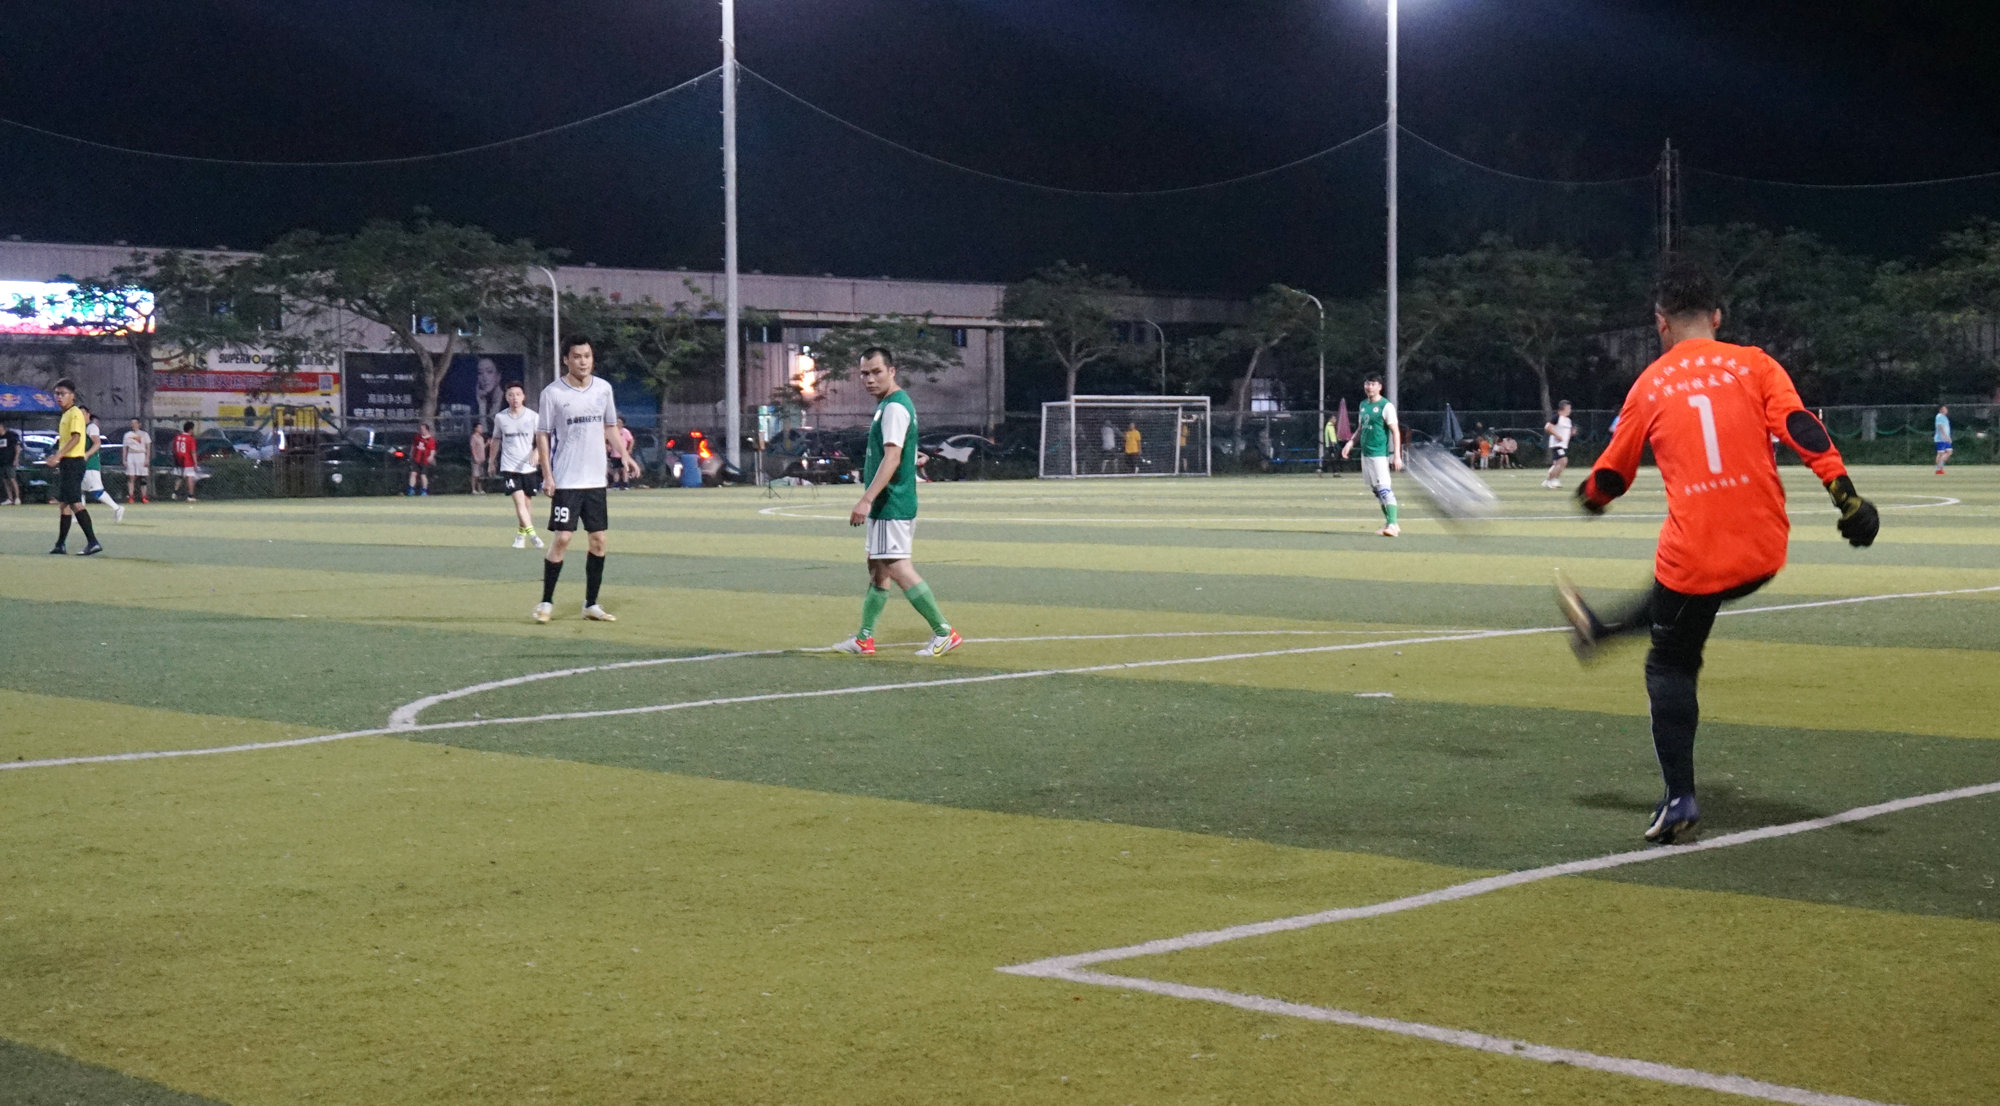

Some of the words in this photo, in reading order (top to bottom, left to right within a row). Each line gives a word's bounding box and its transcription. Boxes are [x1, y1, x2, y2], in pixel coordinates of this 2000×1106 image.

[1688, 394, 1722, 474] 1
[175, 441, 187, 454] 18
[554, 506, 569, 522] 99
